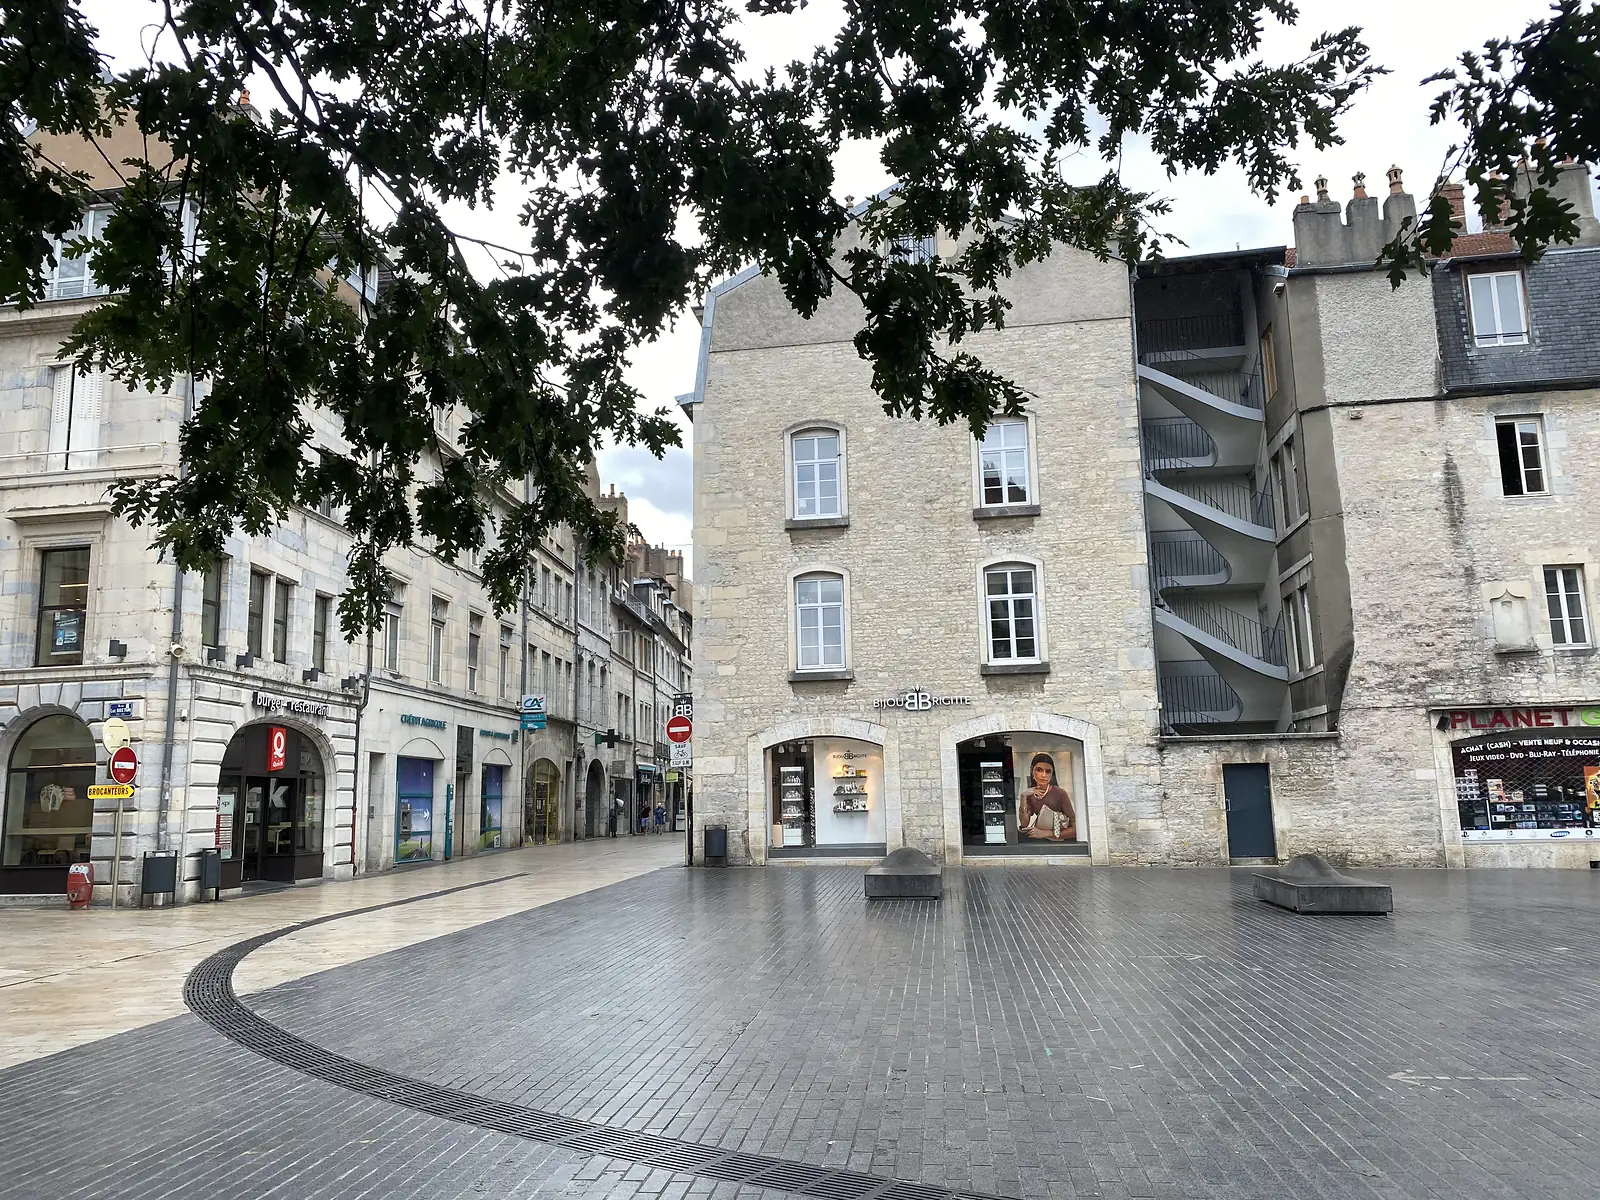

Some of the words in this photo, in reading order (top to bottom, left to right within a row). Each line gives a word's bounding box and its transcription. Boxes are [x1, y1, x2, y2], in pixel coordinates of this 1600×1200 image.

[1449, 708, 1574, 728] PLANET
[274, 731, 285, 759] Q
[1460, 744, 1484, 754] ACHAT
[1486, 740, 1511, 750] (CASH)
[88, 788, 129, 796] BROCANTEURS
